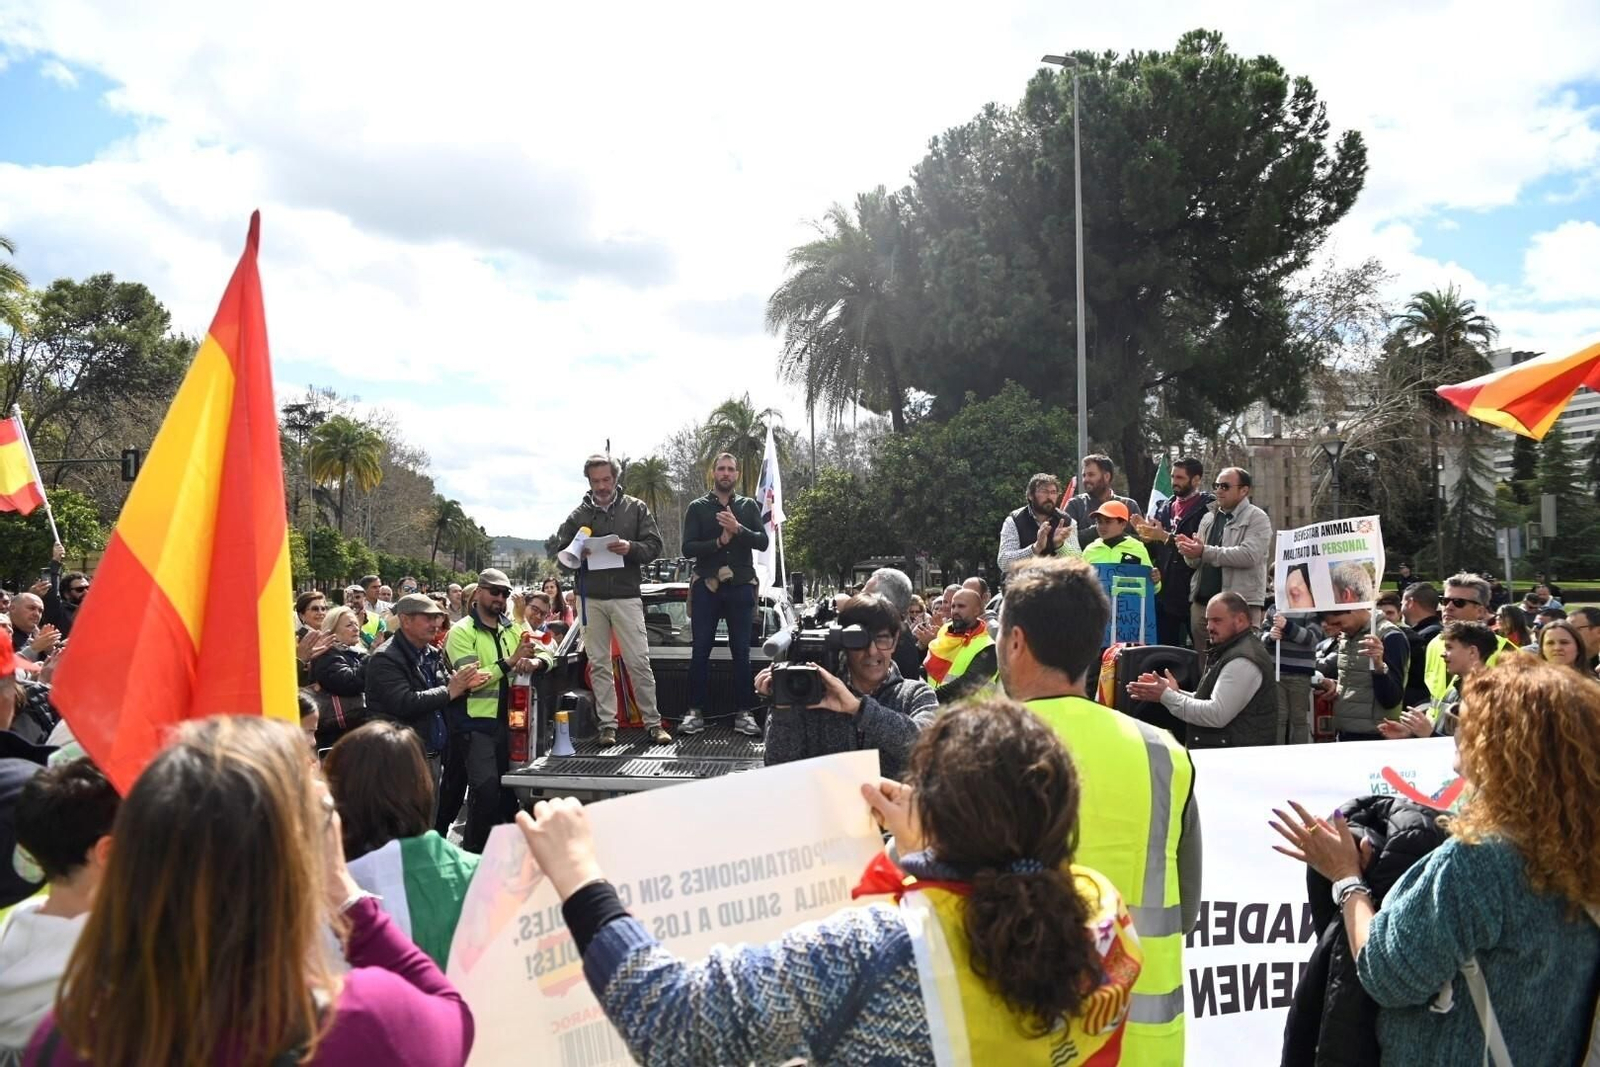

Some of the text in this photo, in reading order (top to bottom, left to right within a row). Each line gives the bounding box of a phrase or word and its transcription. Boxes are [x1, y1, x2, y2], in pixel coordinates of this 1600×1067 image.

[1321, 521, 1355, 538] ANIMAL
[1283, 538, 1369, 562] MALTRATO AL PERSONAL
